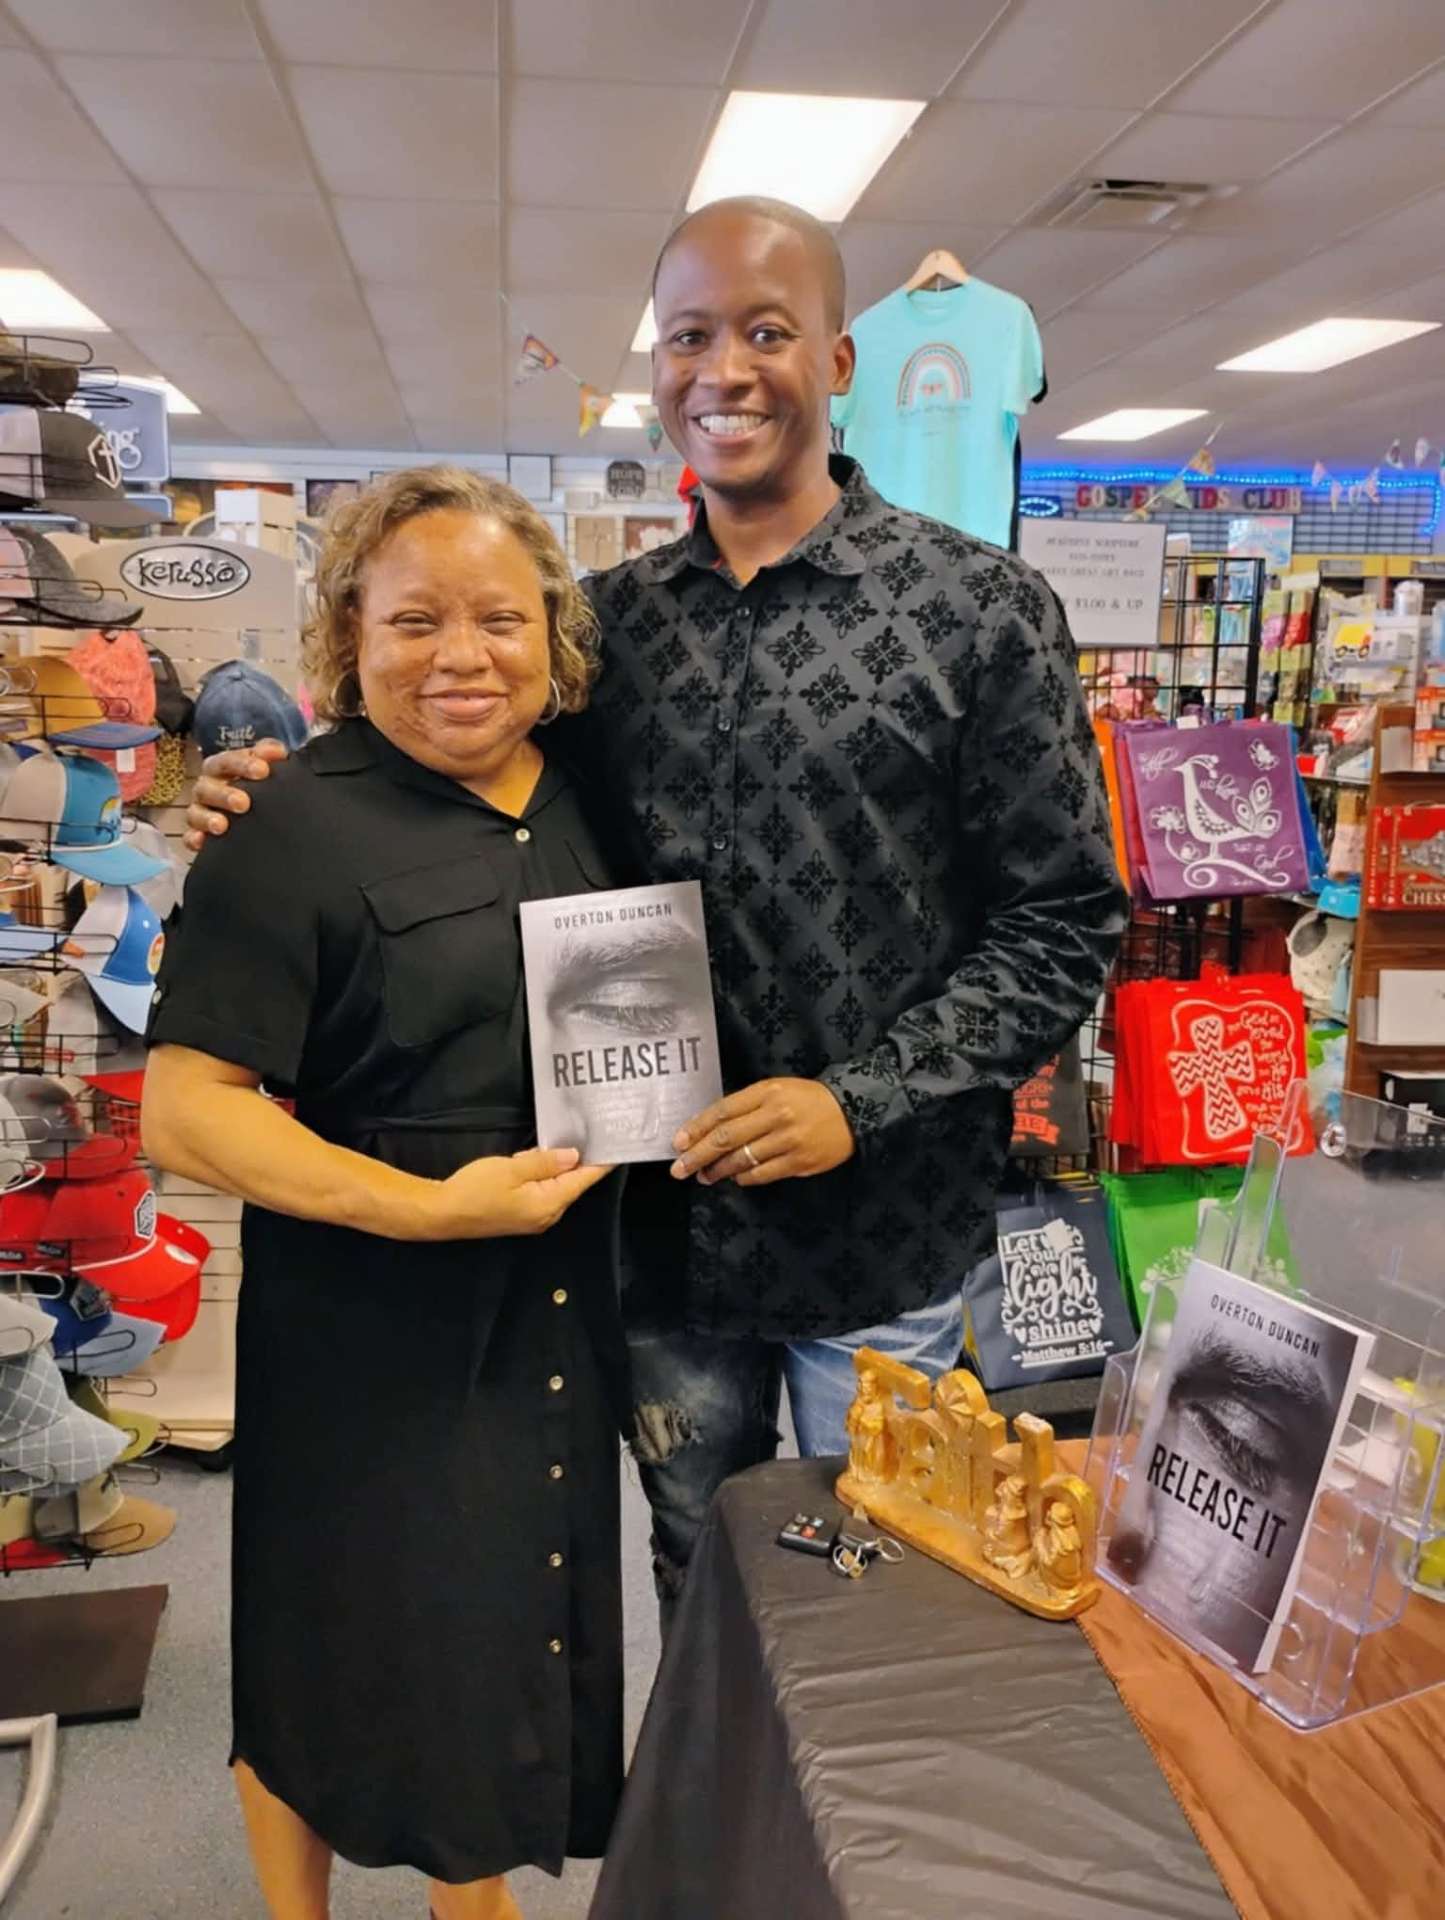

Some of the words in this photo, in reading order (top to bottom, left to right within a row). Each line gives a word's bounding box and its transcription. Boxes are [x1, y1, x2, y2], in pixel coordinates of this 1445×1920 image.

[1174, 486, 1231, 510] IDS
[1243, 486, 1301, 511] CLUB
[1127, 599, 1144, 611] UP
[554, 910, 614, 930] OVERTON
[620, 903, 673, 922] DUNCAN
[552, 1041, 670, 1088] RELEASE
[679, 1036, 702, 1073] IT
[1003, 1234, 1038, 1255] Let
[1010, 1252, 1097, 1318] light
[1028, 1316, 1089, 1342] shine
[1210, 1294, 1265, 1330] OVERTON
[1268, 1321, 1321, 1358] DUNCAN
[1021, 1345, 1075, 1361] Matthew
[1078, 1340, 1105, 1356] 5:16
[1147, 1443, 1254, 1541] RELEASE
[1254, 1510, 1287, 1559] IT
